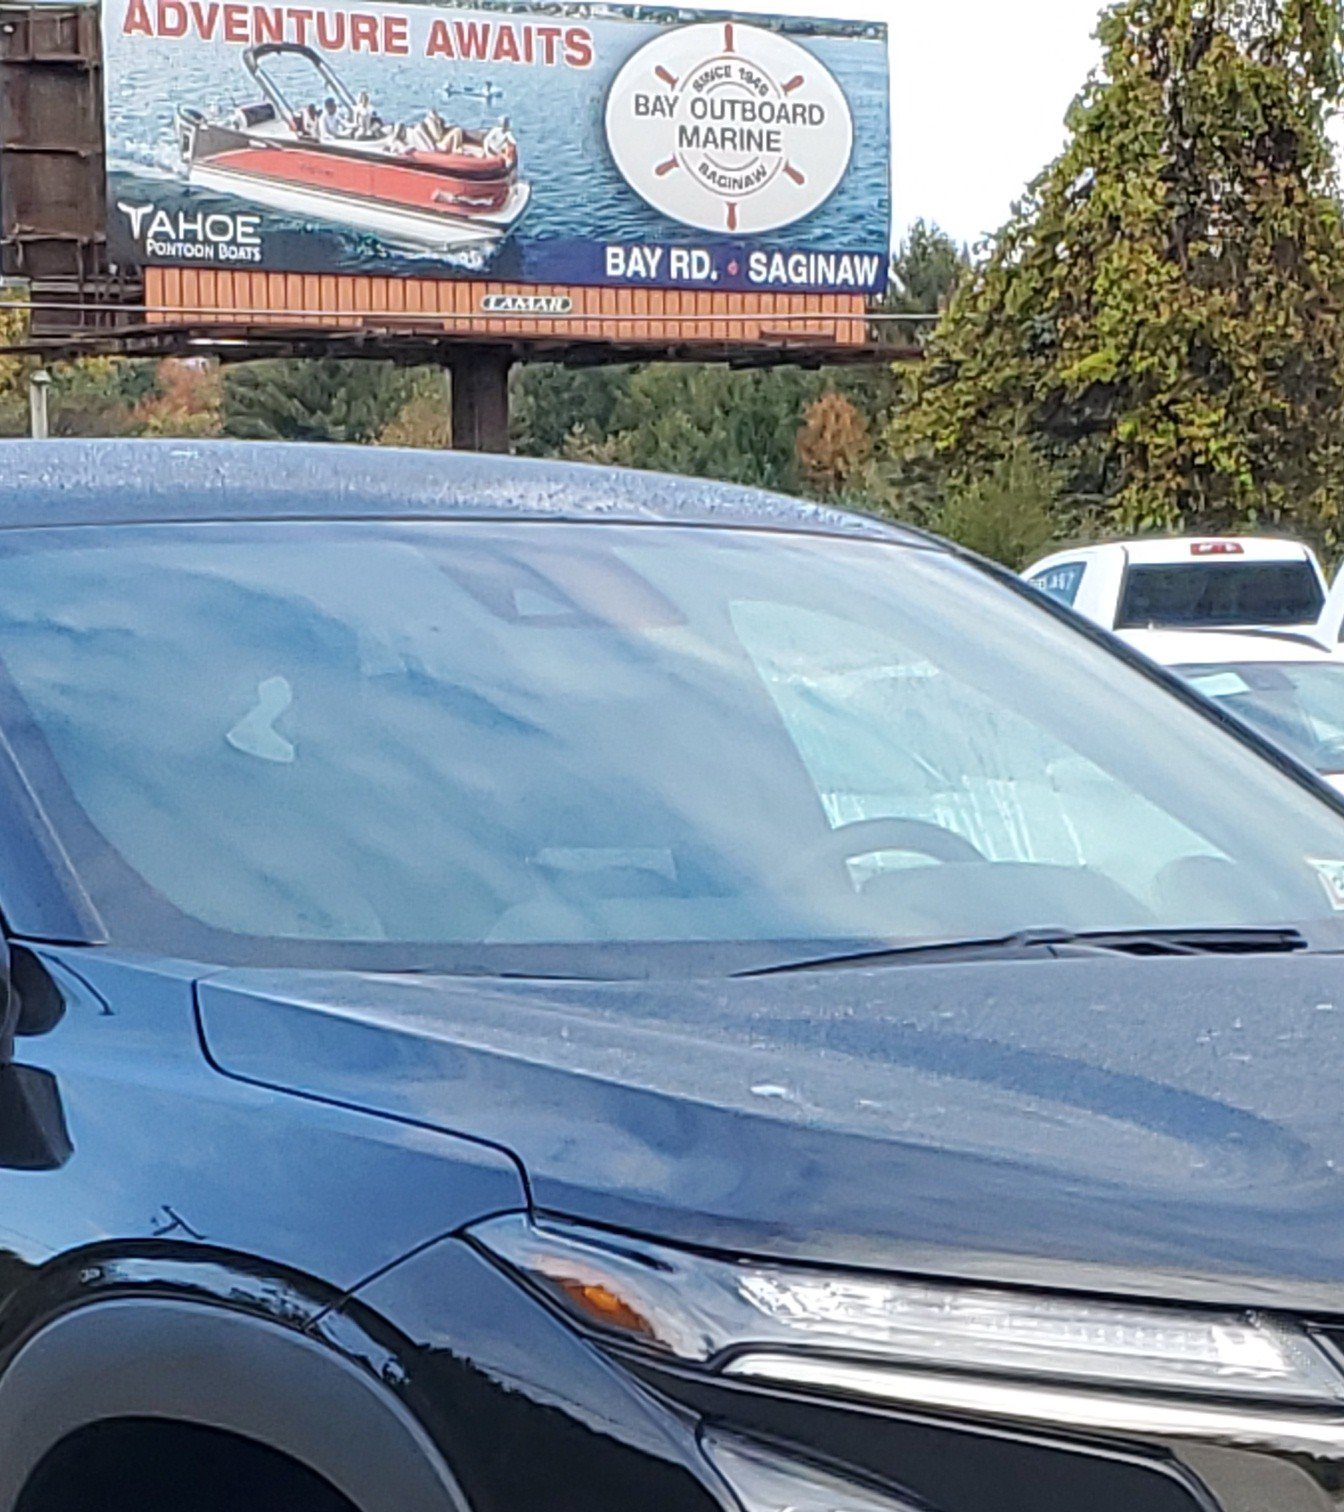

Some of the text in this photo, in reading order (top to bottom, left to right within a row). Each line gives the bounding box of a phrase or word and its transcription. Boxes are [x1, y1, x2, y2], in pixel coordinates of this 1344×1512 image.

[123, 0, 593, 66] ADVENTURE AWAITS
[692, 65, 731, 92] SINCE
[635, 94, 824, 126] BAY OUTBOARD
[678, 125, 782, 152] MARINE
[698, 162, 767, 190] SAGINAW
[117, 201, 262, 244] TAHOE
[146, 238, 262, 261] PONTOON BOATS
[607, 247, 878, 284] BAY RD. SAGINAW
